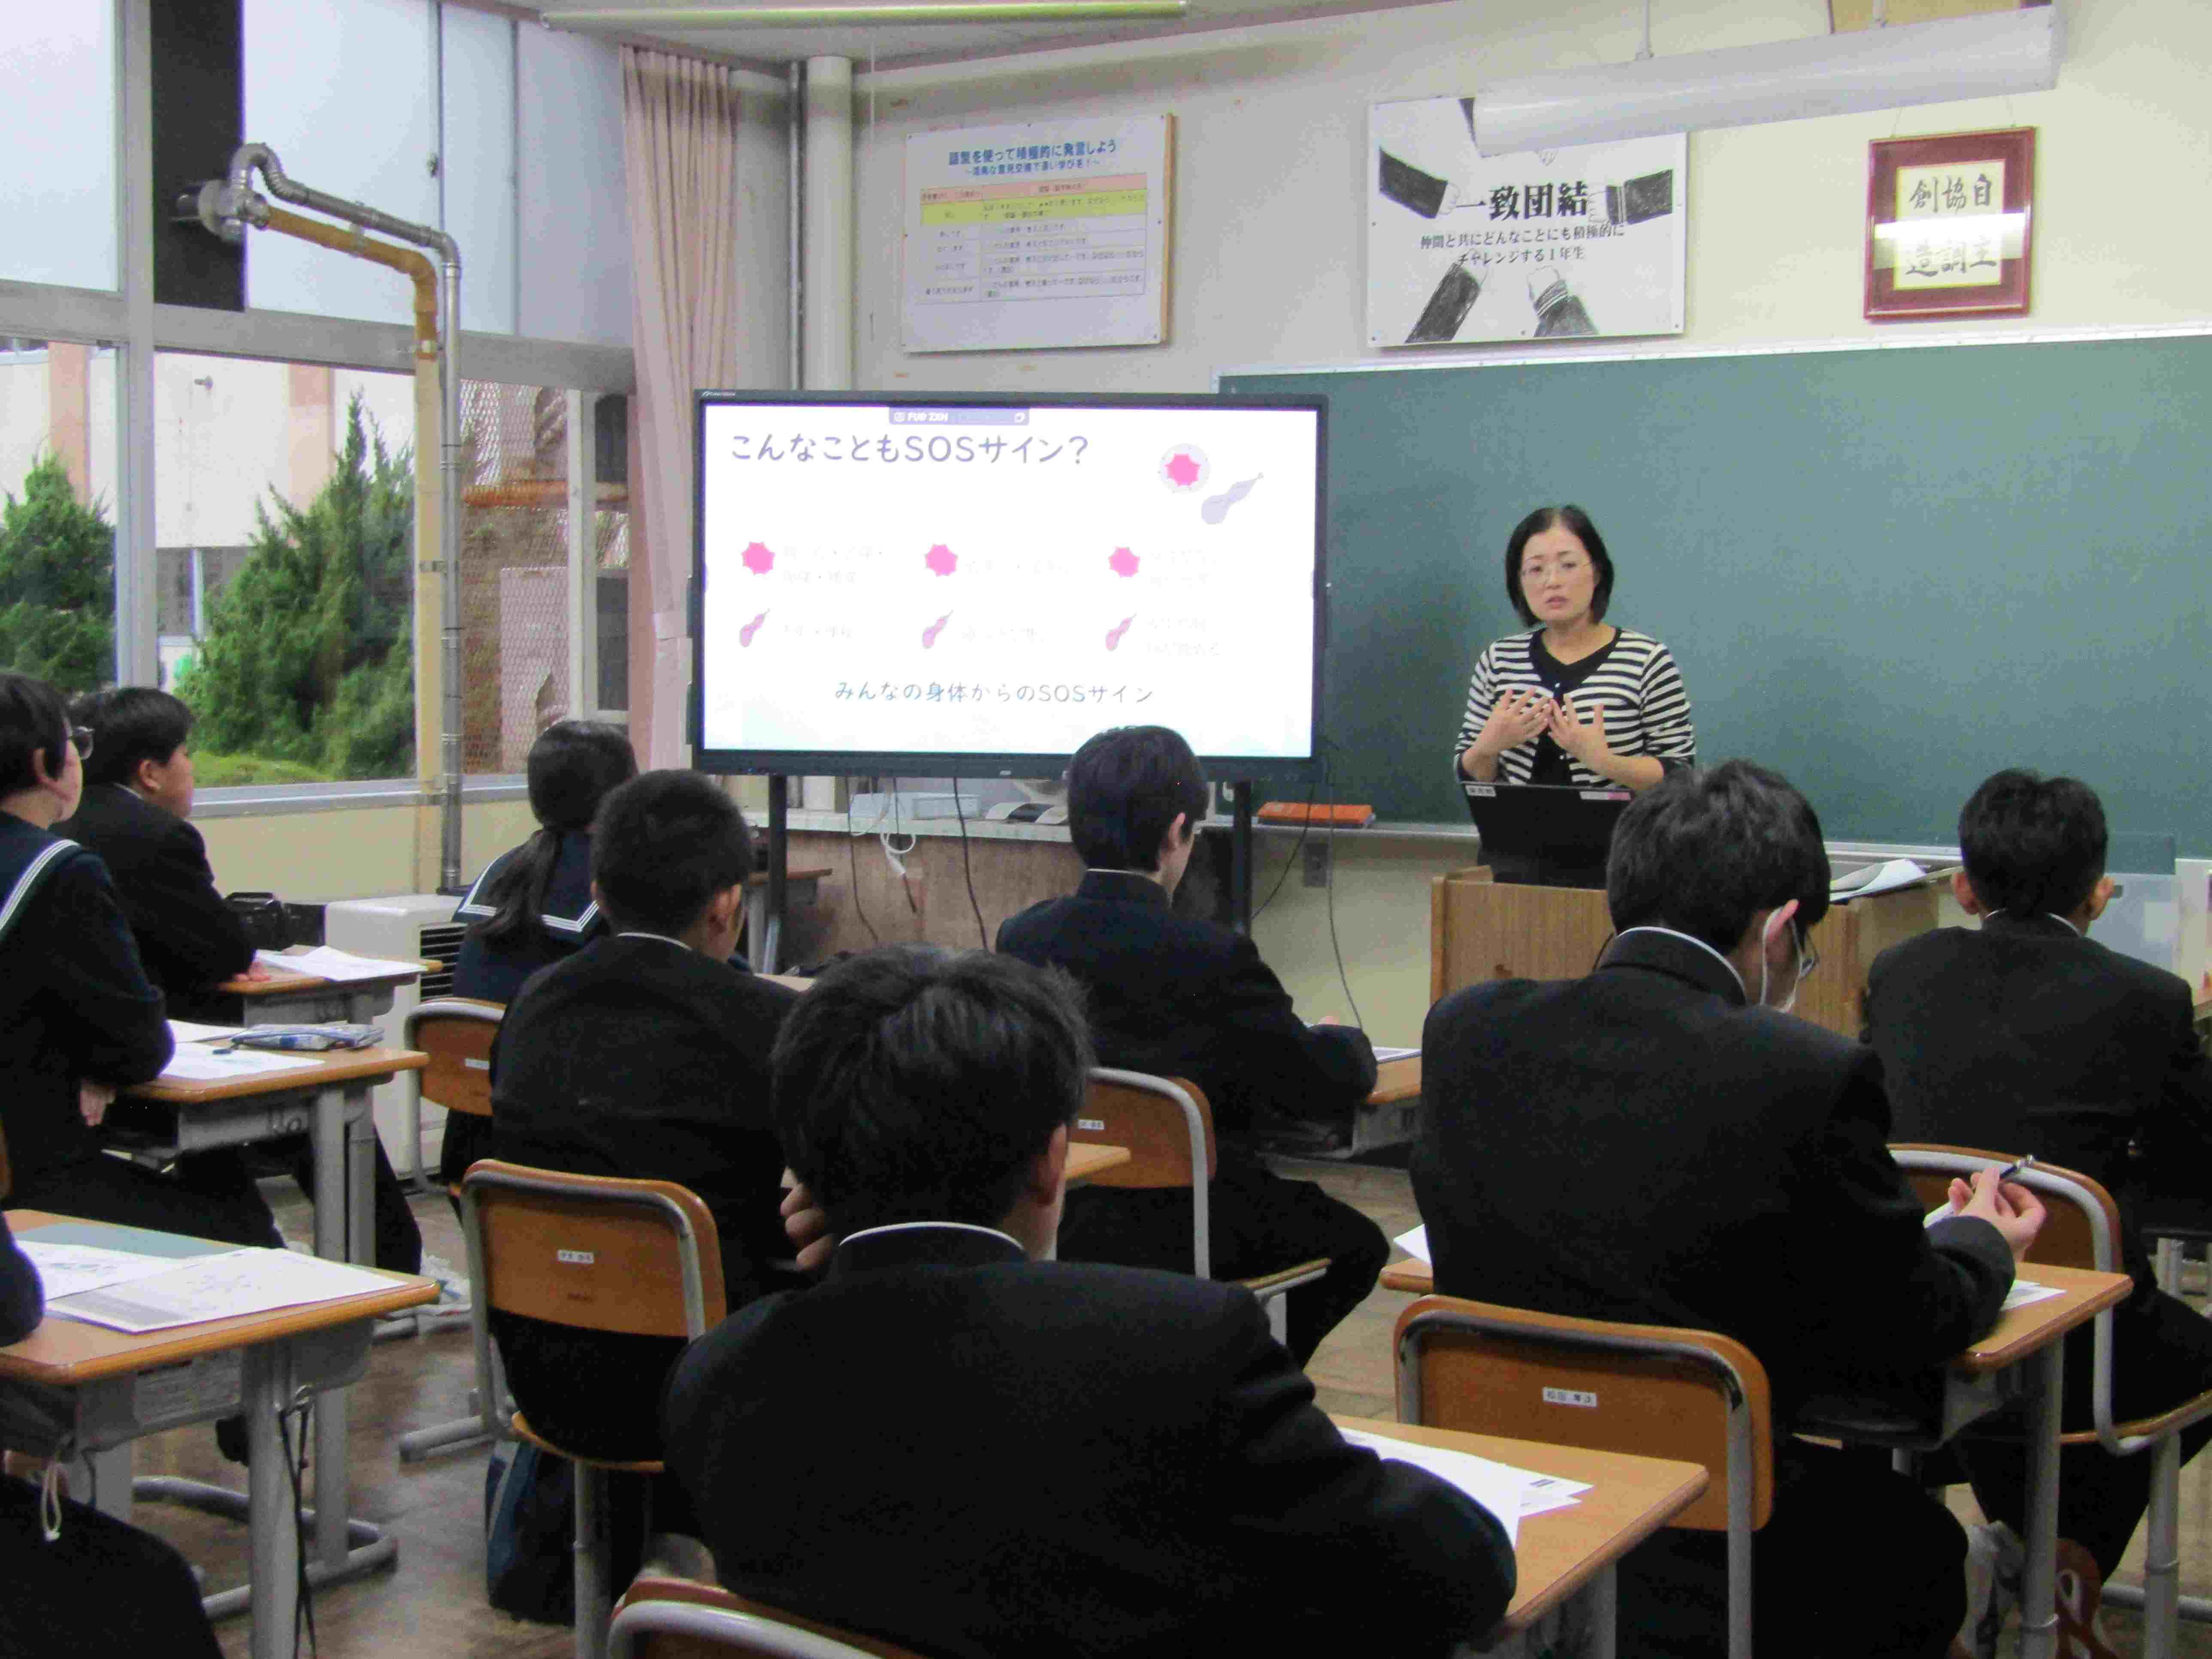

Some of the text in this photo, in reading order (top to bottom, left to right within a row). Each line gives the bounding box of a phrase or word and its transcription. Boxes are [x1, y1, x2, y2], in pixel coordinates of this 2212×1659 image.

[1455, 180, 1589, 221] 一致団結
[1420, 224, 1625, 249] 仲間と共にどんなことにも積極的に
[835, 681, 1152, 703] みんなの身体からのSOSサイン
